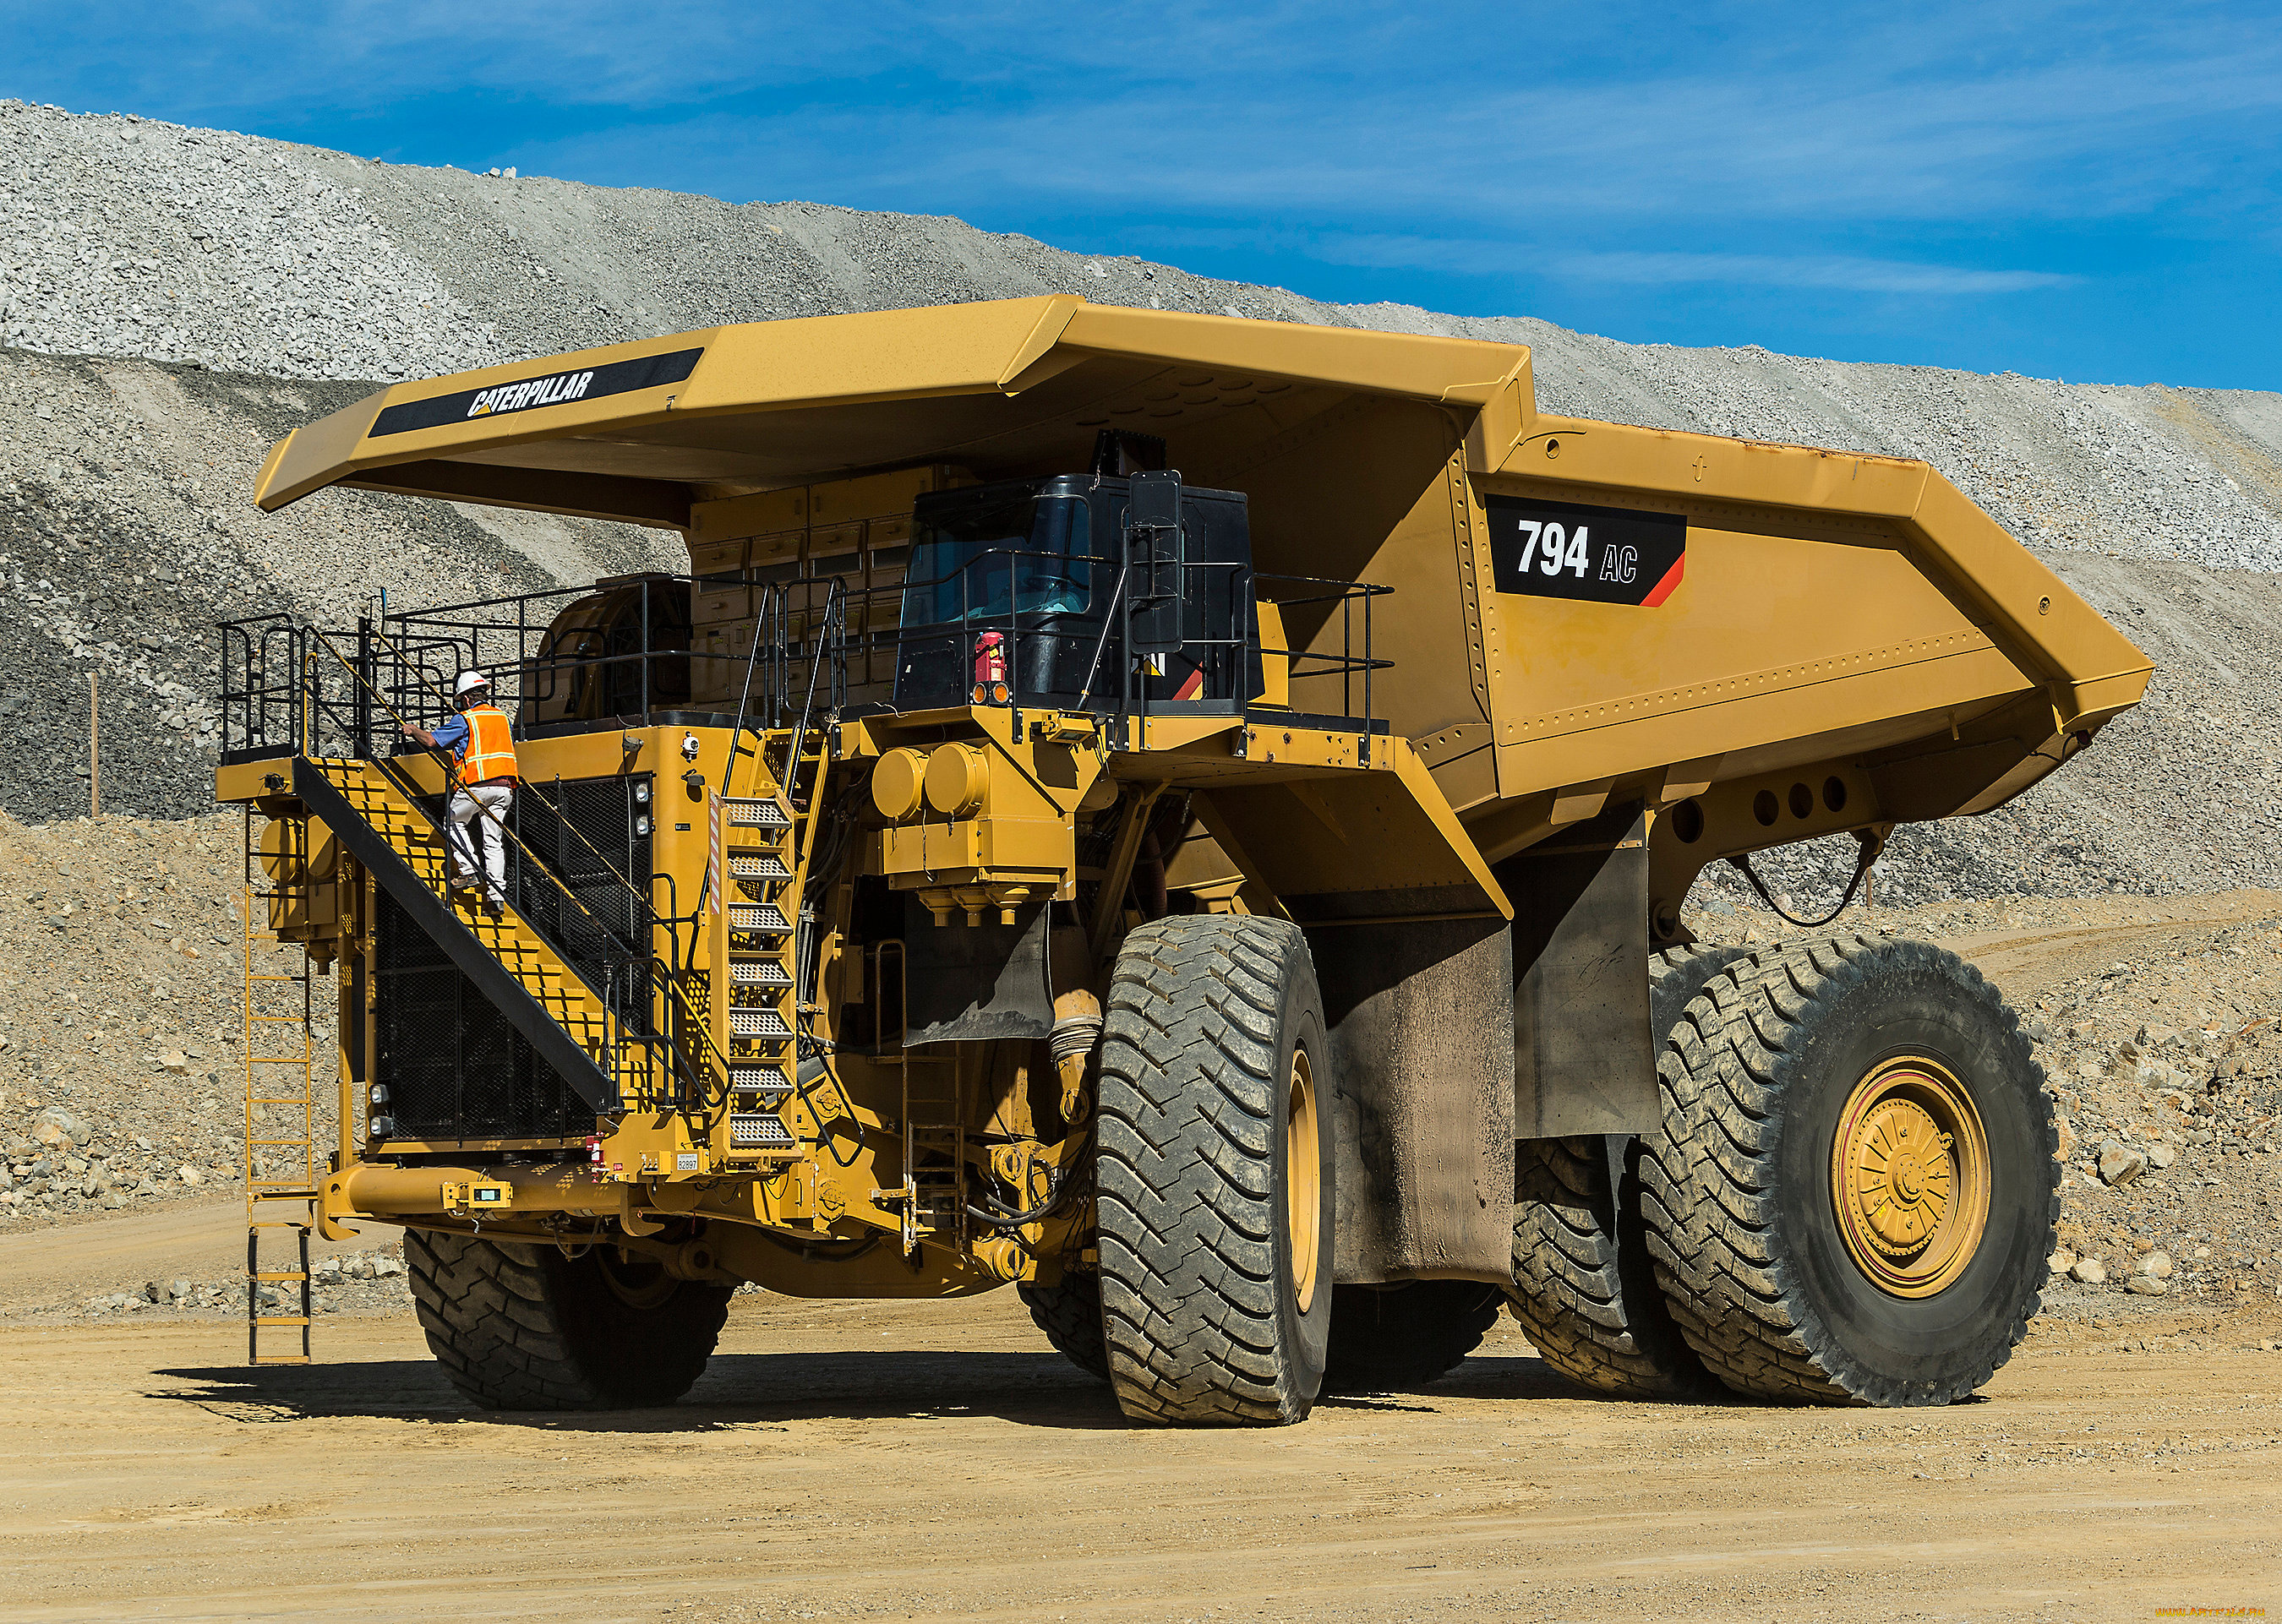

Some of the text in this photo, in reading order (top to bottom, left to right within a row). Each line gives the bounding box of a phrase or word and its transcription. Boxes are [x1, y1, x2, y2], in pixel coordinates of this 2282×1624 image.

[467, 371, 594, 417] CATERPILLAR
[1518, 519, 1638, 584] 794 AC
[679, 1160, 696, 1169] 82897
